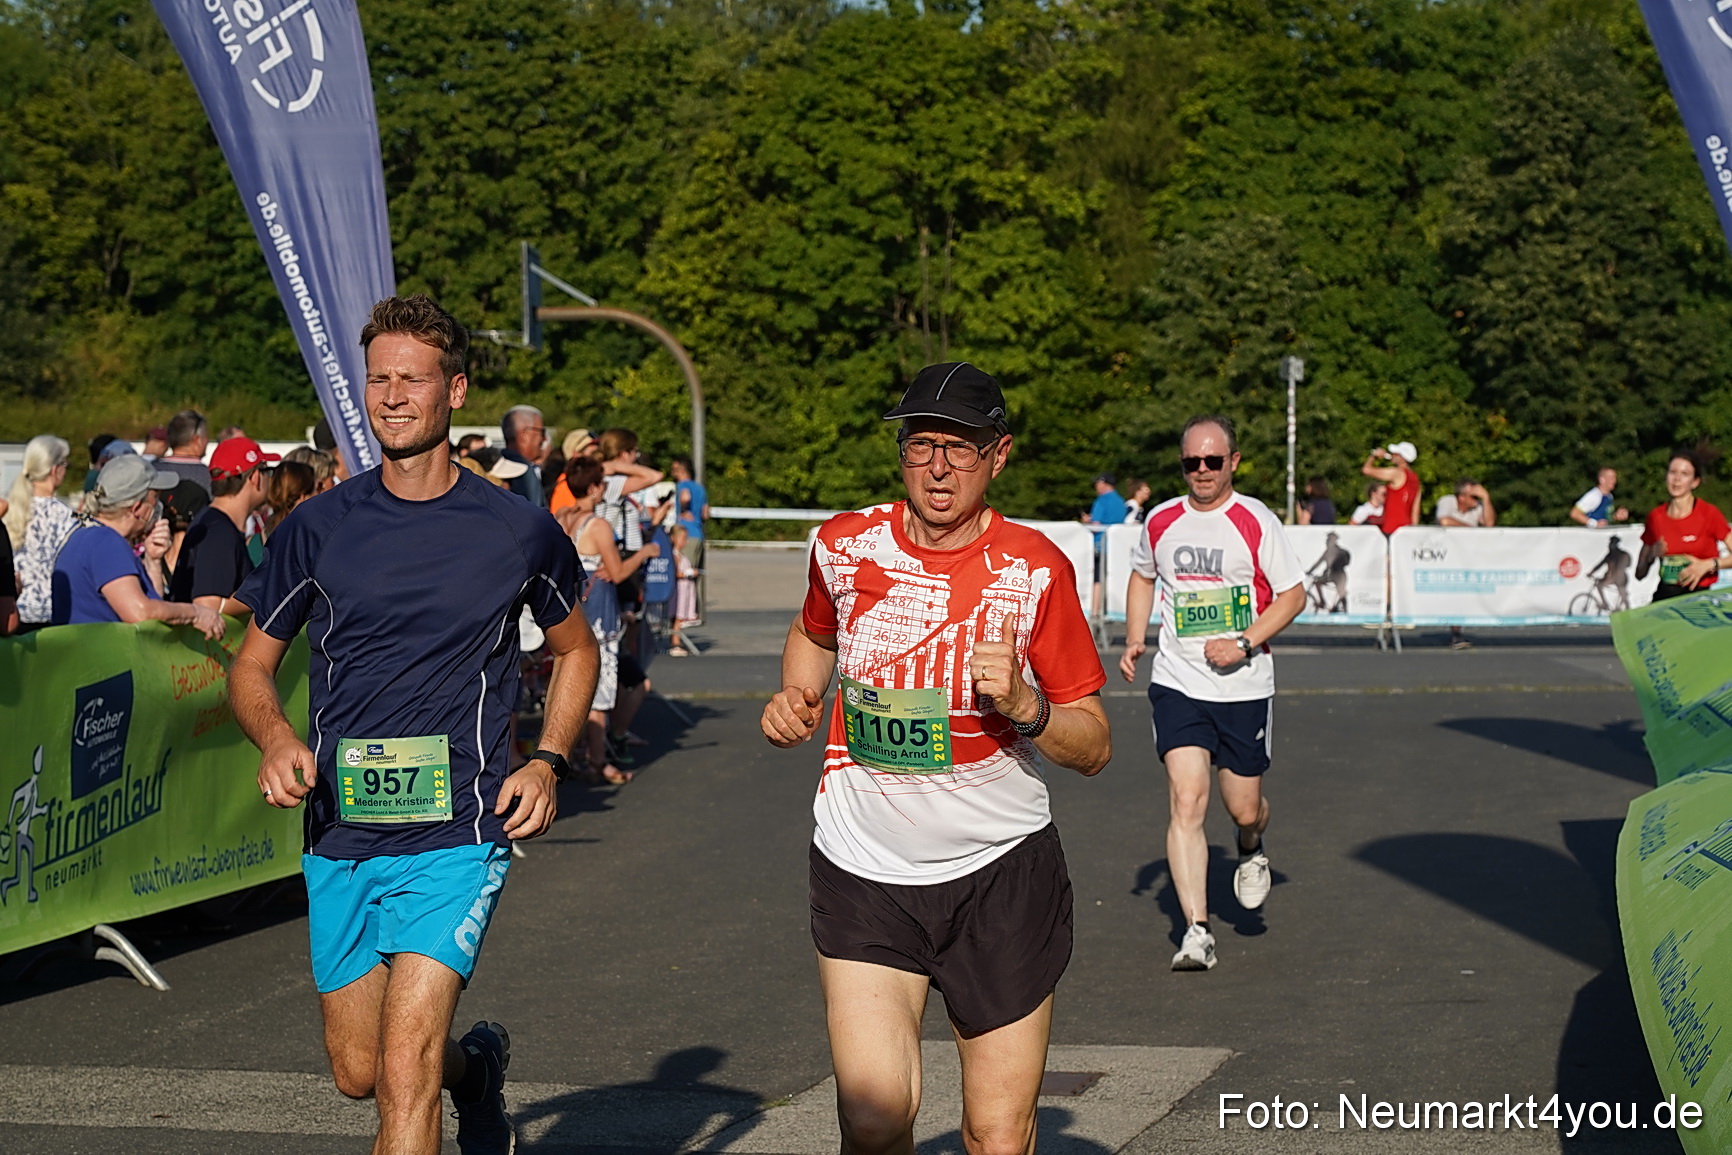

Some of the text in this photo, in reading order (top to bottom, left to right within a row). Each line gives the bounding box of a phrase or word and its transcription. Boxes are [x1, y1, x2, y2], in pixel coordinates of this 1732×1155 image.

[1173, 545, 1224, 574] OM
[1187, 604, 1218, 622] 500
[872, 629, 908, 645] 26.22
[846, 713, 855, 744] RUN
[854, 710, 929, 746] 1105
[931, 722, 946, 762] 2022
[857, 739, 928, 760] Schilling Arnd
[343, 777, 355, 806] RUN
[363, 767, 420, 796] 957
[433, 769, 446, 808] 2022
[45, 746, 172, 863] firmenlauf
[354, 796, 435, 807] Mederer Kristina
[45, 846, 103, 892] neumarkt
